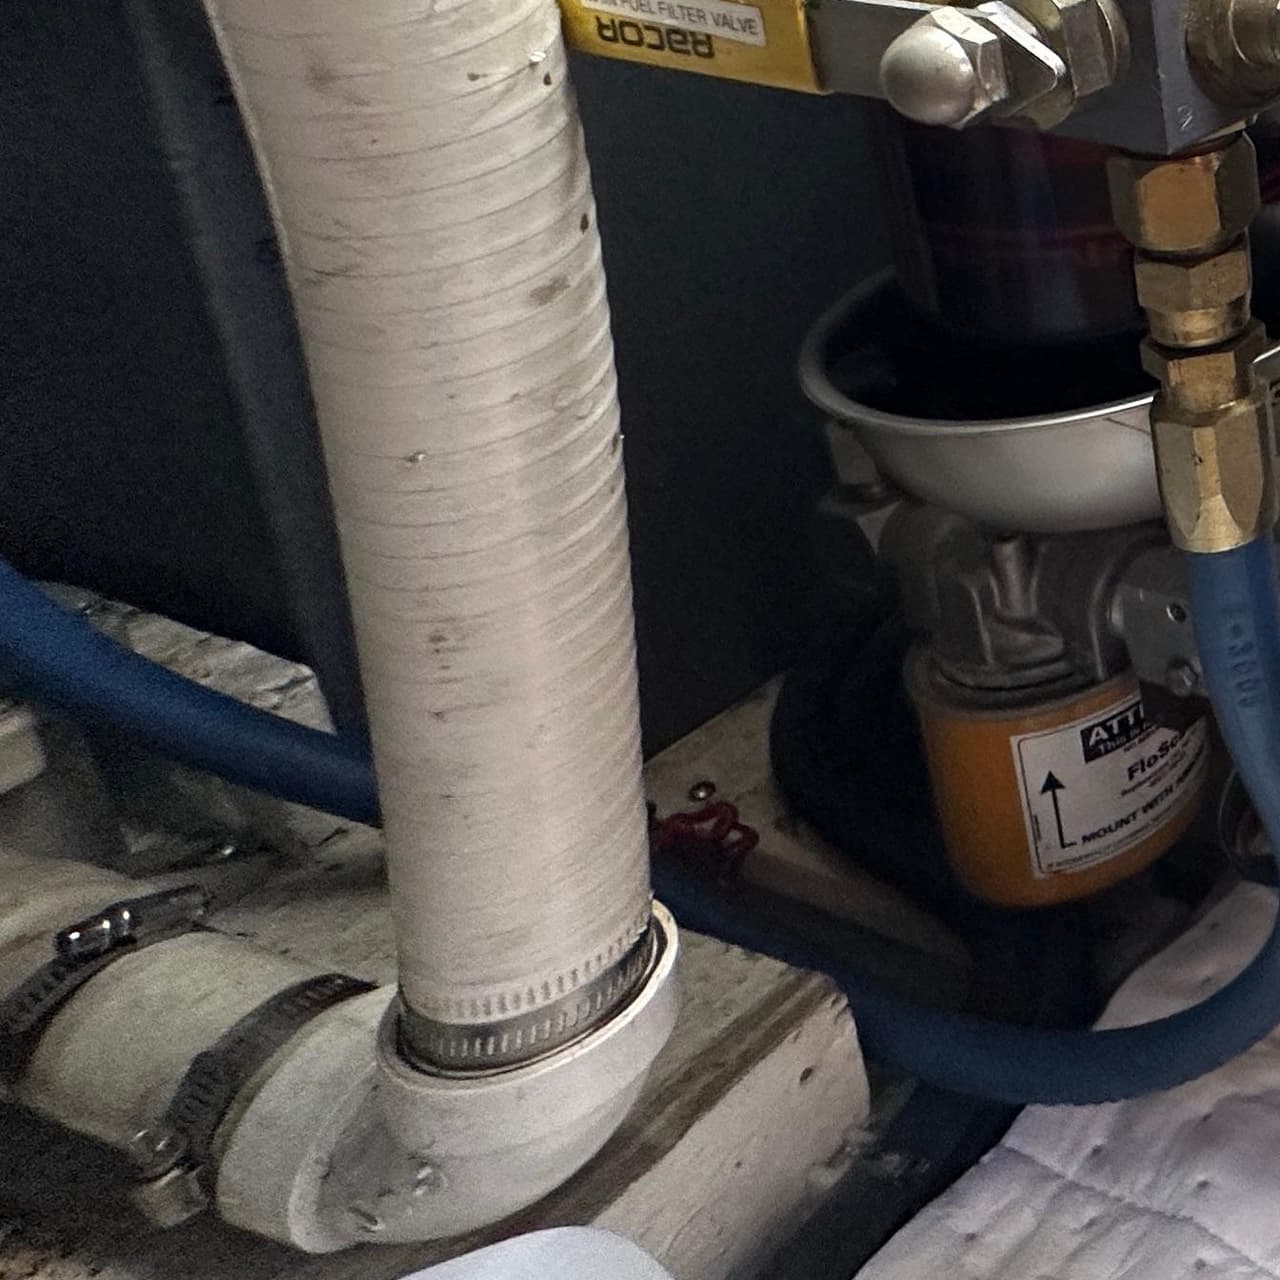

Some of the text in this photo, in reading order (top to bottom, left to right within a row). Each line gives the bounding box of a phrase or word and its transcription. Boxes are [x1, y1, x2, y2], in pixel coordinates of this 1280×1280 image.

[656, 0, 707, 27] FILTER
[710, 11, 760, 36] VALVE
[1081, 811, 1139, 845] MOUNT
